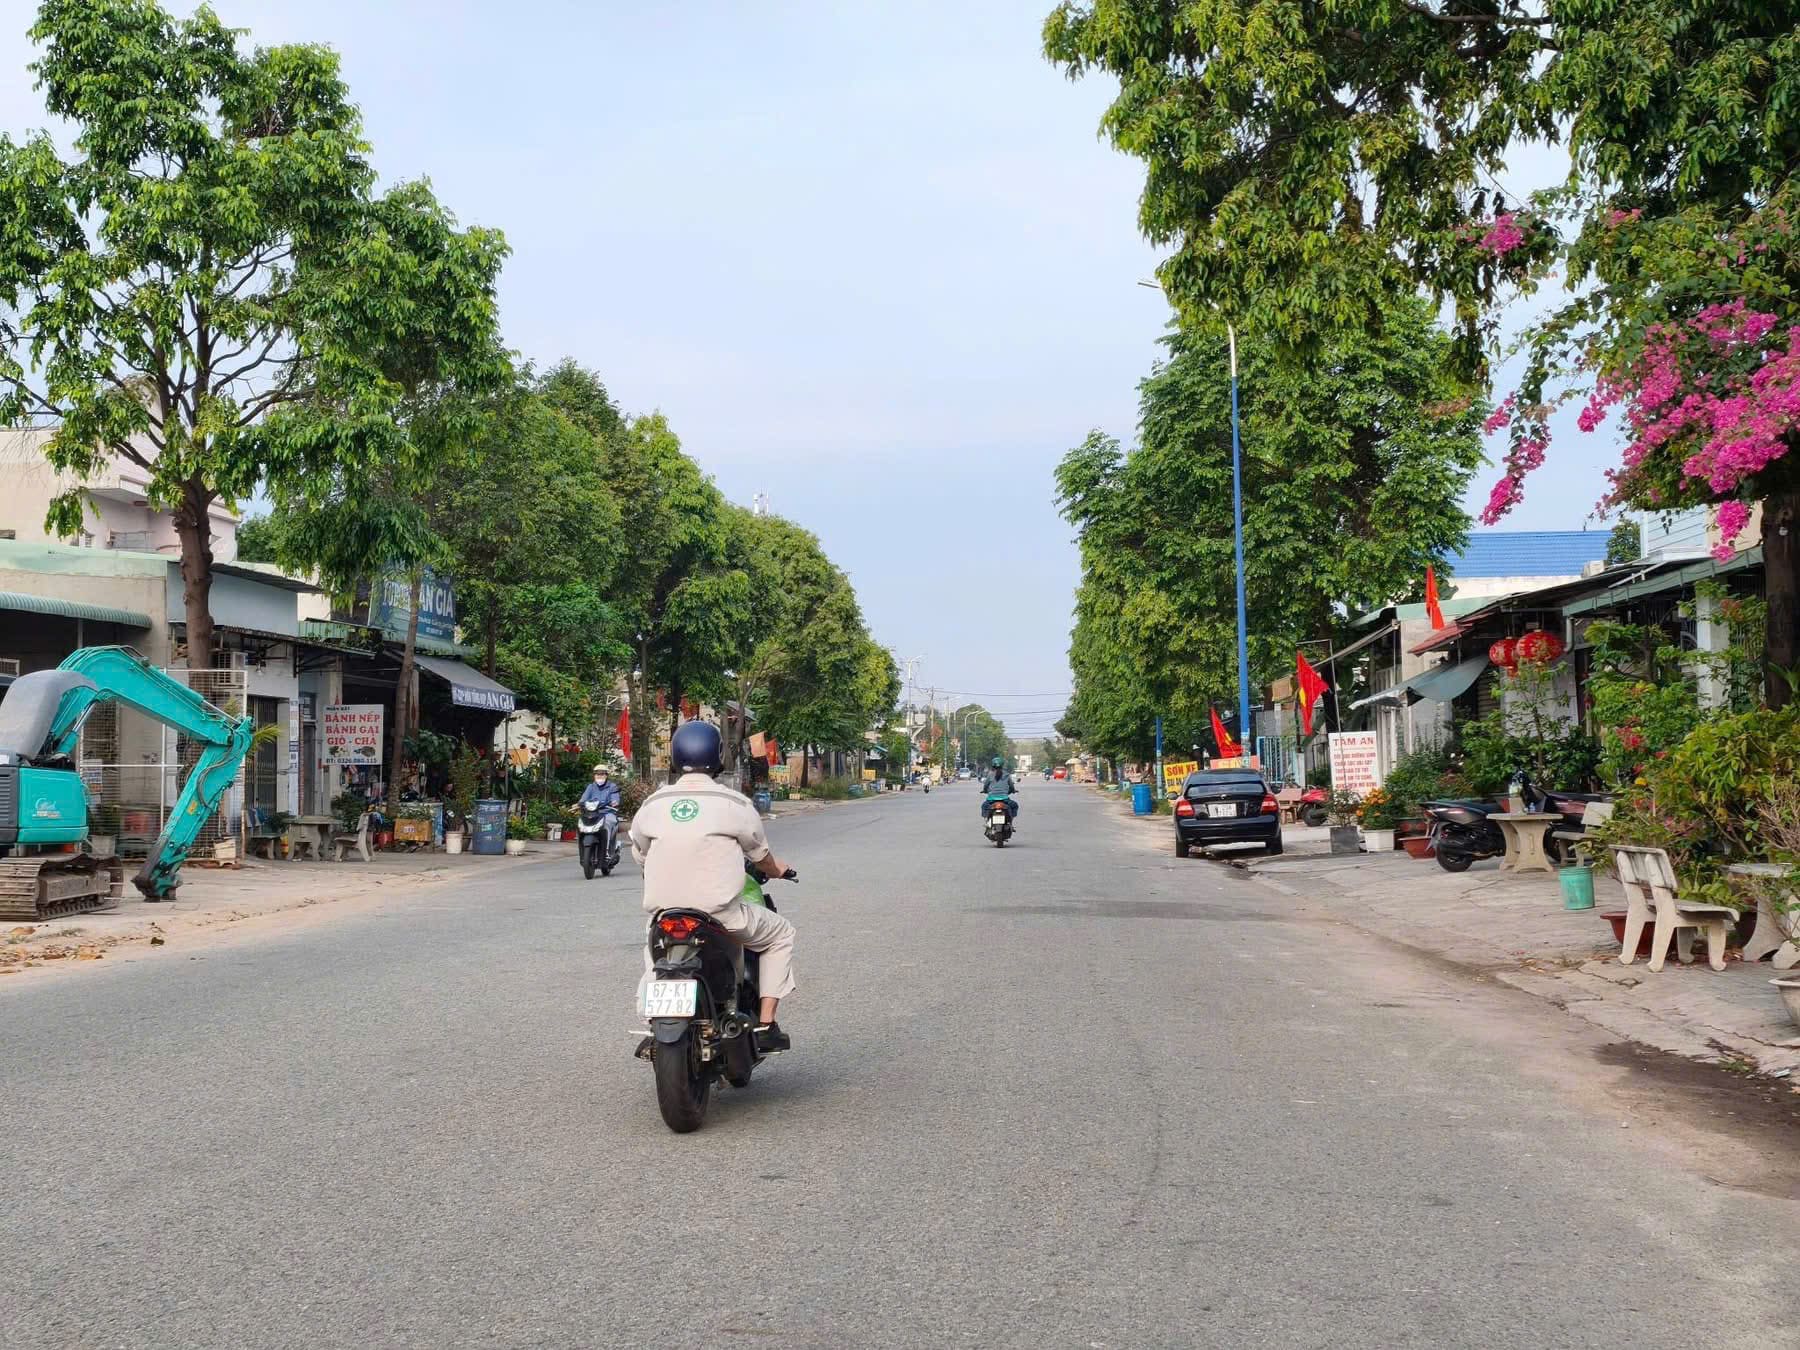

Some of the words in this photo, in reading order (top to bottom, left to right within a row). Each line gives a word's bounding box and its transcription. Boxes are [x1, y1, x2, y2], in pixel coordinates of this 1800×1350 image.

[435, 588, 454, 618] GIA
[487, 692, 499, 708] AN
[499, 694, 515, 711] GIA
[325, 711, 356, 723] BÁNH
[359, 710, 381, 723] NẾP
[326, 723, 357, 735] BÁNH
[1167, 765, 1184, 776] SƠN
[653, 983, 688, 998] 67-K1
[647, 1000, 693, 1015] 577.82
